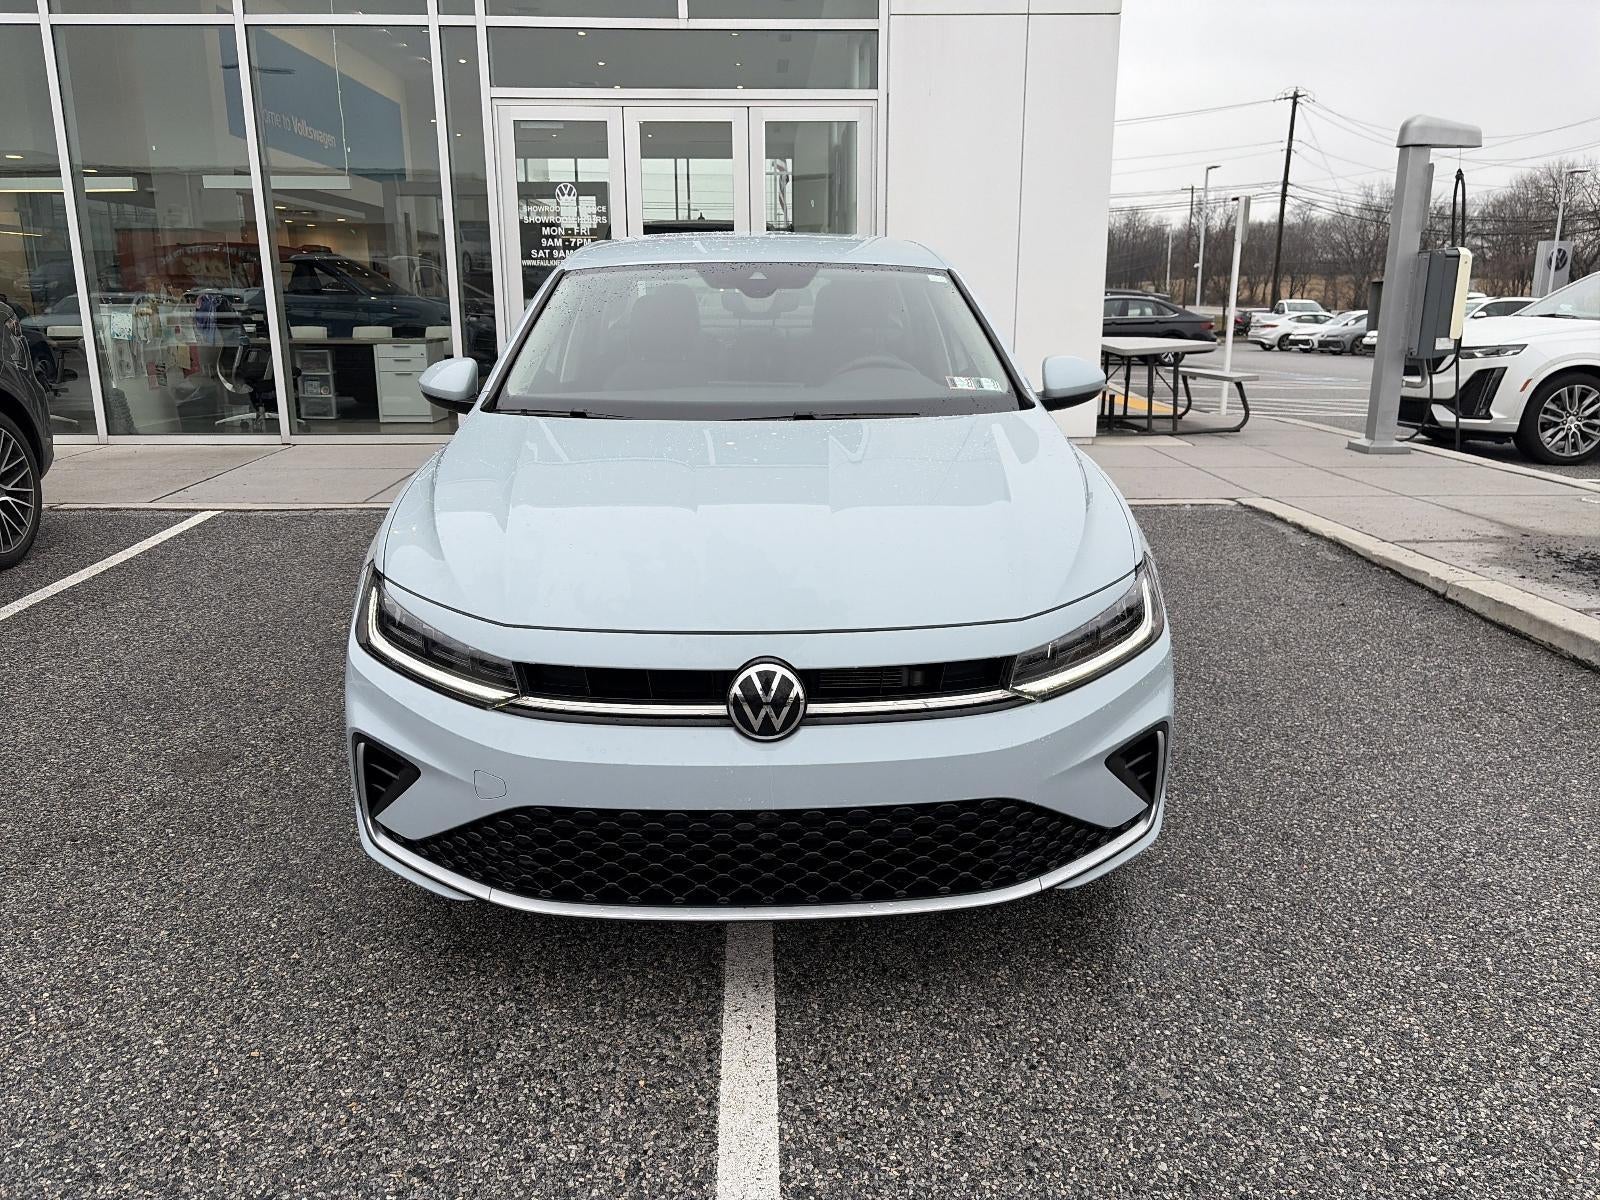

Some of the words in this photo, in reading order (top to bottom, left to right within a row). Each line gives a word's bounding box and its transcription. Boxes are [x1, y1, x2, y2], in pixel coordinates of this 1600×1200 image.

[291, 115, 337, 148] Volkswagen
[523, 205, 567, 213] SHOWROO
[523, 216, 576, 224] SHOWROO
[541, 226, 565, 236] MON
[574, 226, 591, 236] FRI
[541, 238, 563, 247] 9AM
[569, 238, 592, 247] 7PM
[530, 249, 551, 258] SAT
[552, 249, 574, 258] 9AM
[521, 259, 563, 267] WWW.FAULKNE
